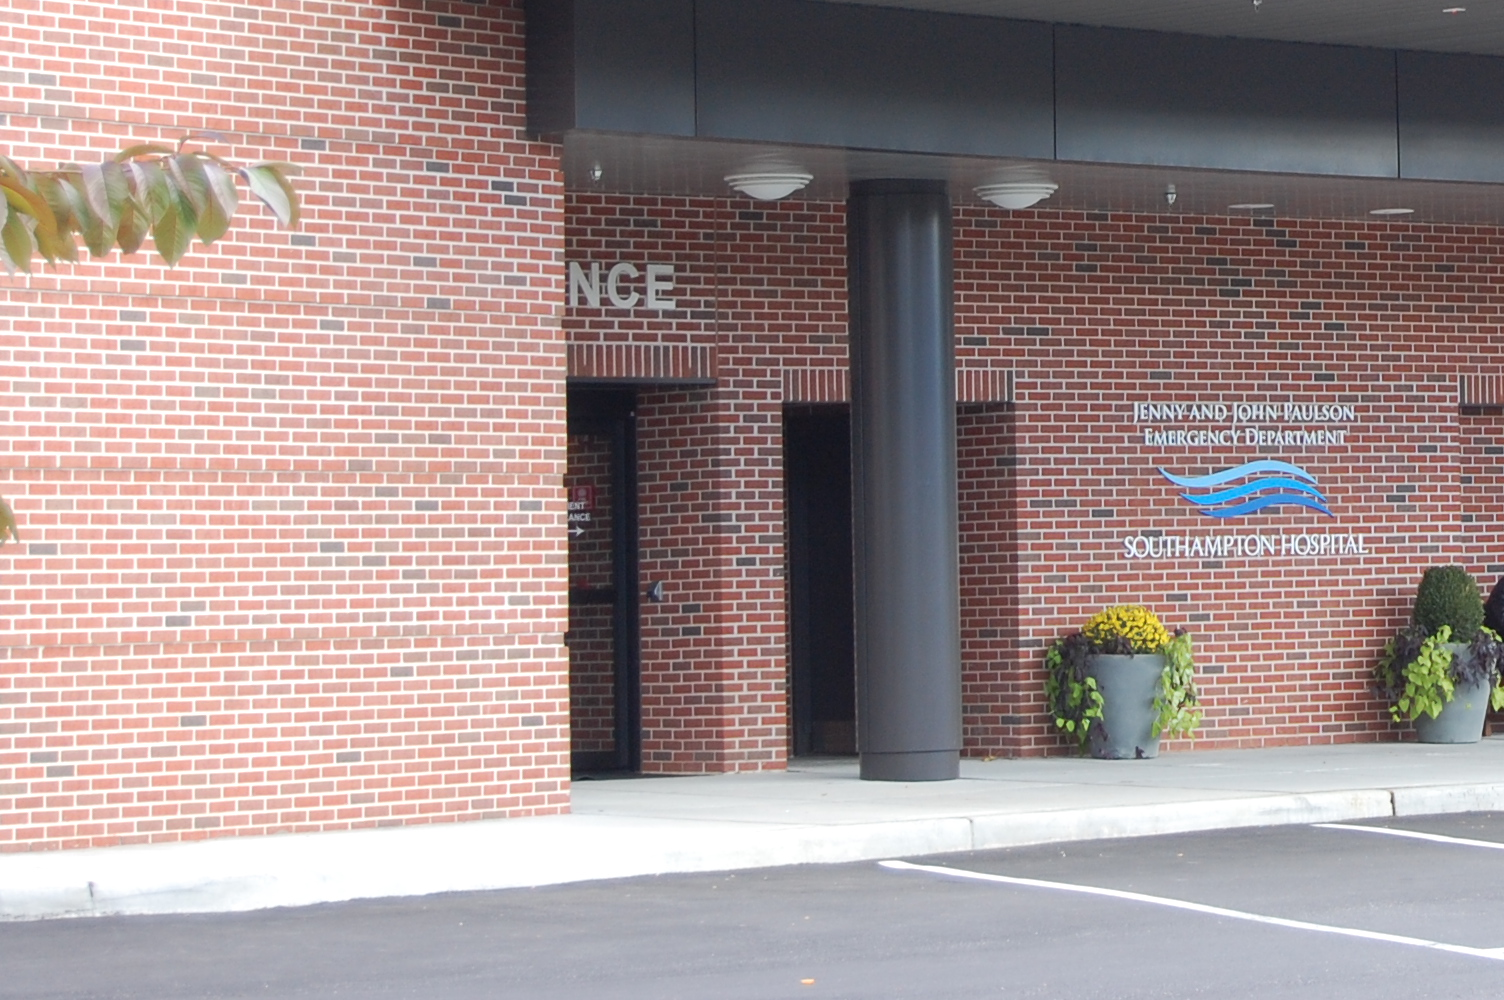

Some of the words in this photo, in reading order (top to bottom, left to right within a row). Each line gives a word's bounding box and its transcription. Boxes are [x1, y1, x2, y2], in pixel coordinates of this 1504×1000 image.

[1133, 402, 1185, 424] JENNY
[1189, 403, 1228, 421] AND
[1231, 402, 1278, 423] JOHN
[1283, 402, 1355, 422] PAULSON
[1143, 428, 1240, 446] EMERGENCY
[1244, 428, 1347, 446] DEPARTMENT
[1123, 533, 1275, 559] SOUTHAMPTON
[1280, 533, 1369, 557] HOSPITAL
